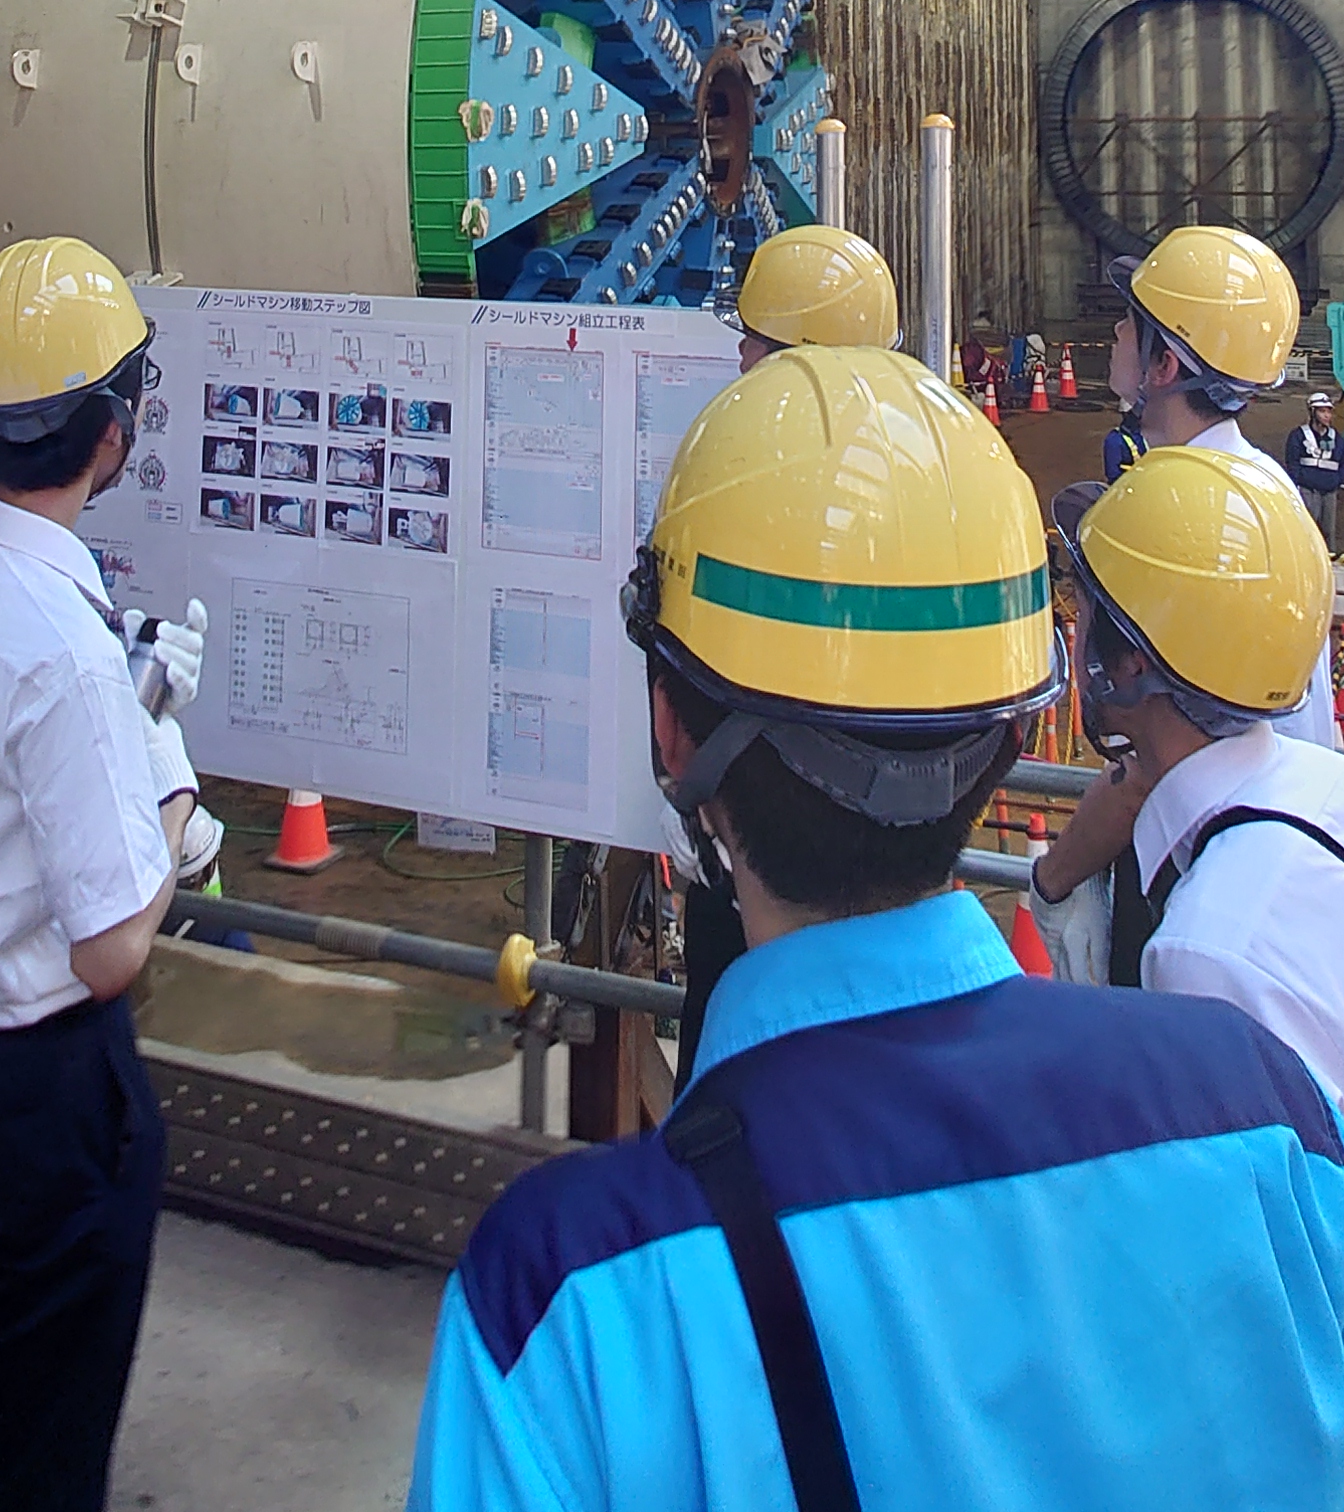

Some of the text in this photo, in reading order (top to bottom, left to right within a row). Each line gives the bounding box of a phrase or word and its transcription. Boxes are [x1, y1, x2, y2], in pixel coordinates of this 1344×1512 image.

[213, 294, 371, 315] シールドマシン移動ステップ図
[489, 309, 646, 331] シールドマシン組立工程表
